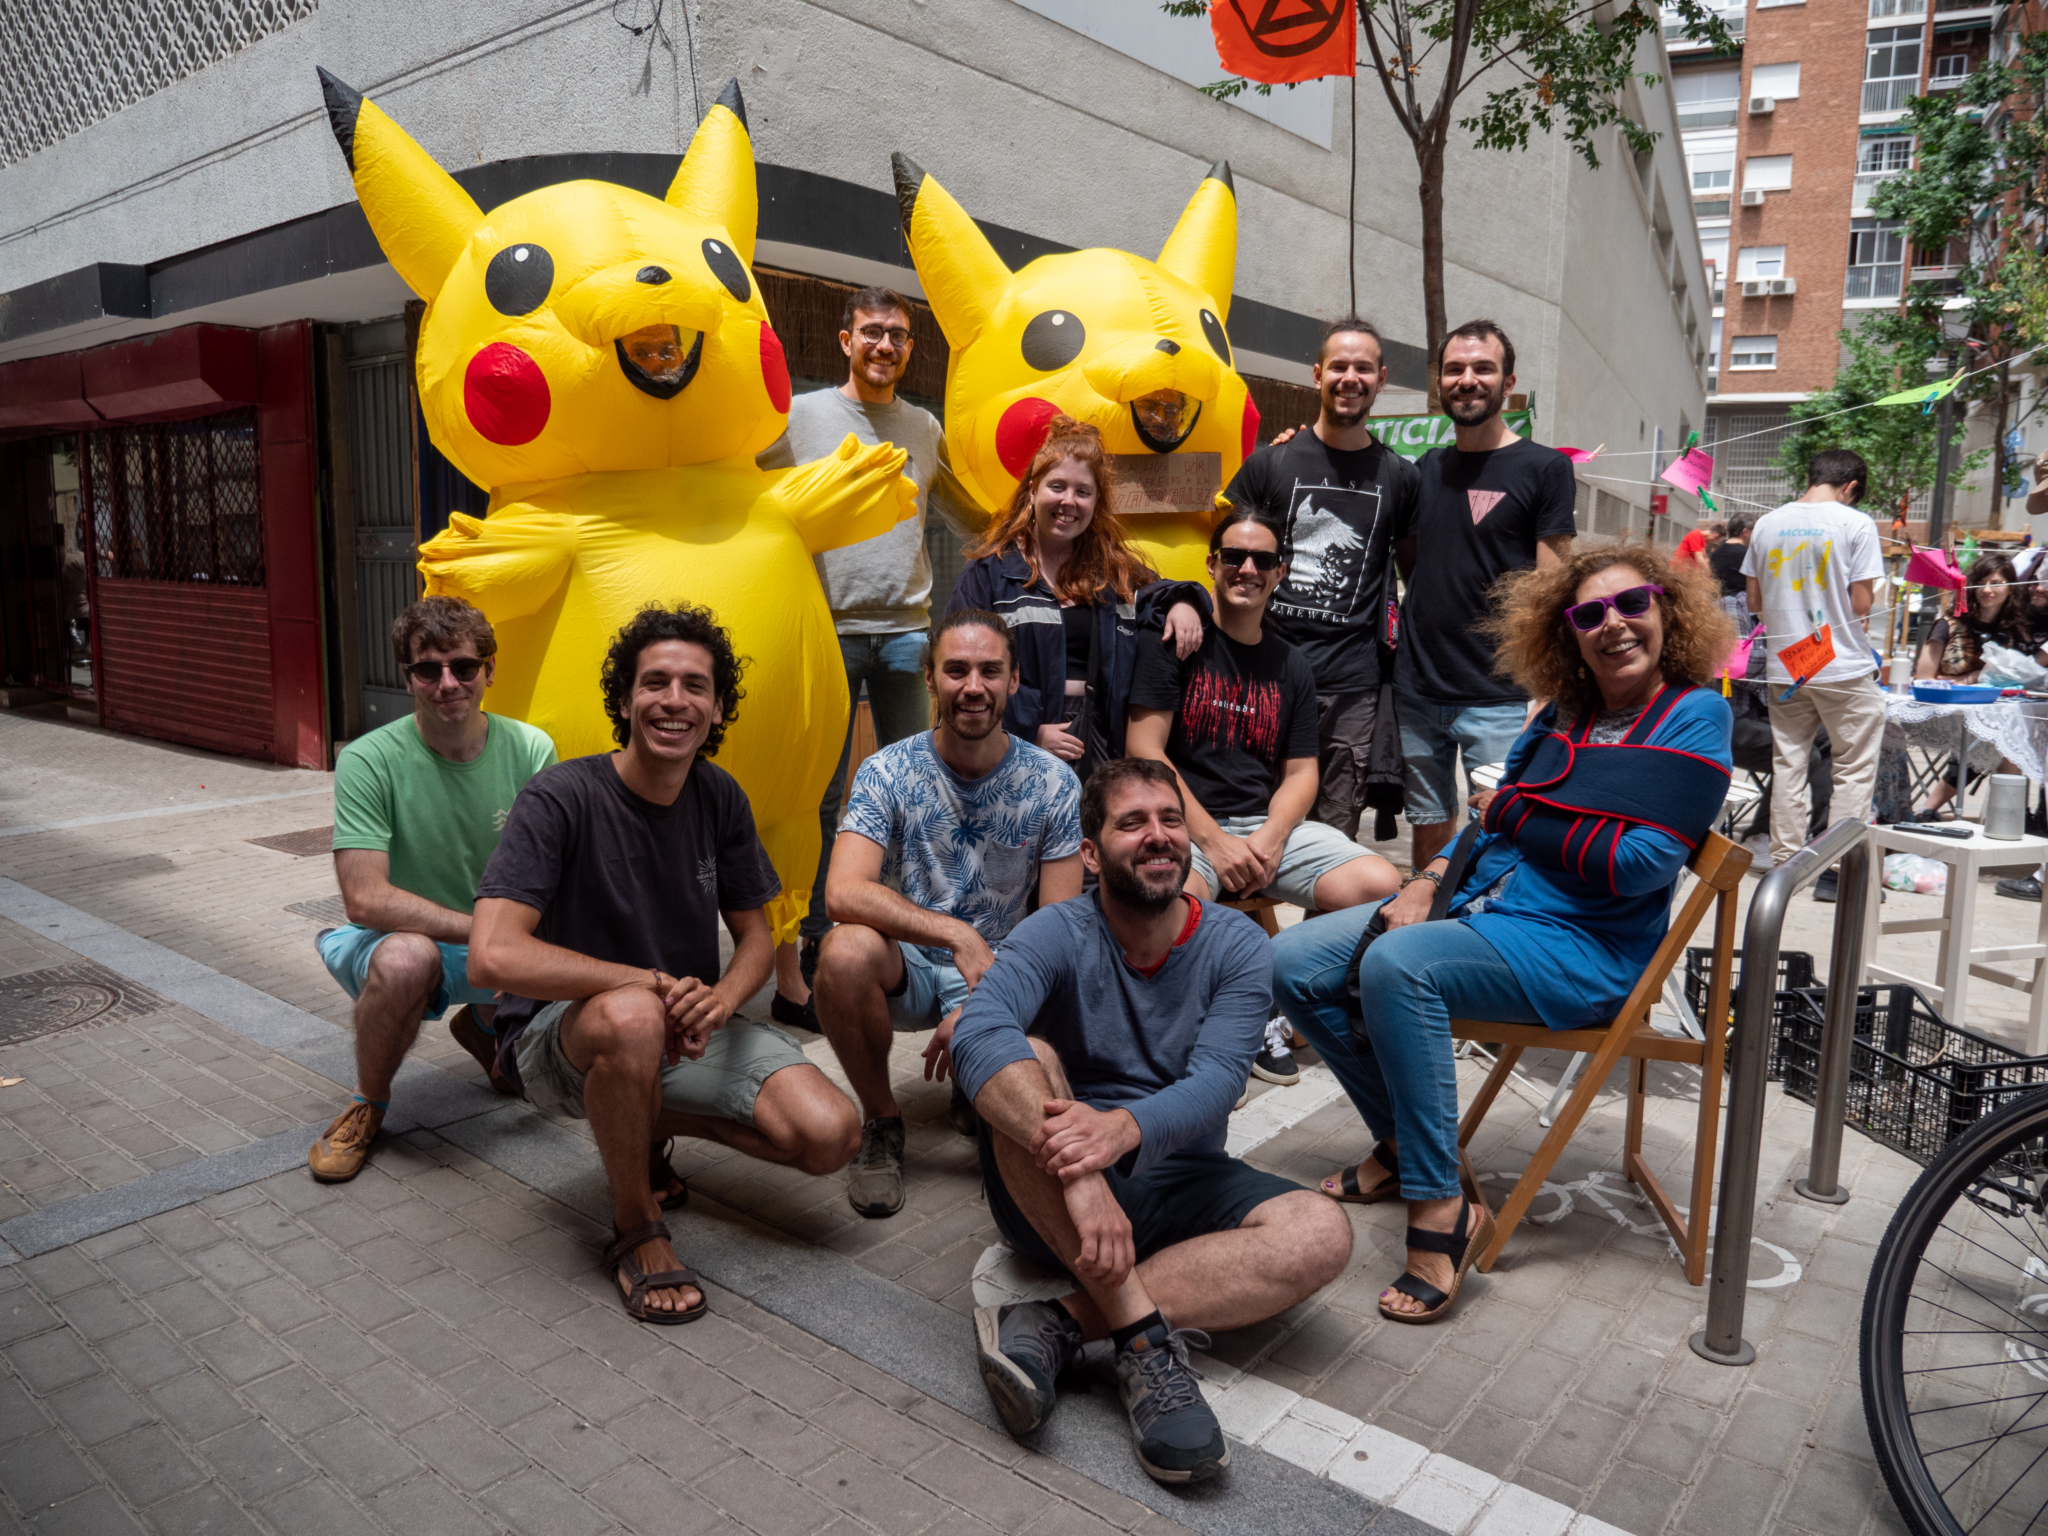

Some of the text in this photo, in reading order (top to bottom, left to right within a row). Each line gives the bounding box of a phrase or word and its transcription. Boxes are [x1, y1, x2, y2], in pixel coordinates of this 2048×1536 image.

[1365, 418, 1457, 446] TICIA
[1117, 461, 1206, 475] KACHUS POR
[1137, 475, 1181, 488] DERECHO
[1185, 477, 1192, 485] A
[1198, 477, 1211, 486] LA
[1294, 477, 1383, 494] LAST
[1270, 603, 1349, 623] FAREWELL
[1789, 661, 1797, 671] Y
[1212, 699, 1256, 714] solitude
